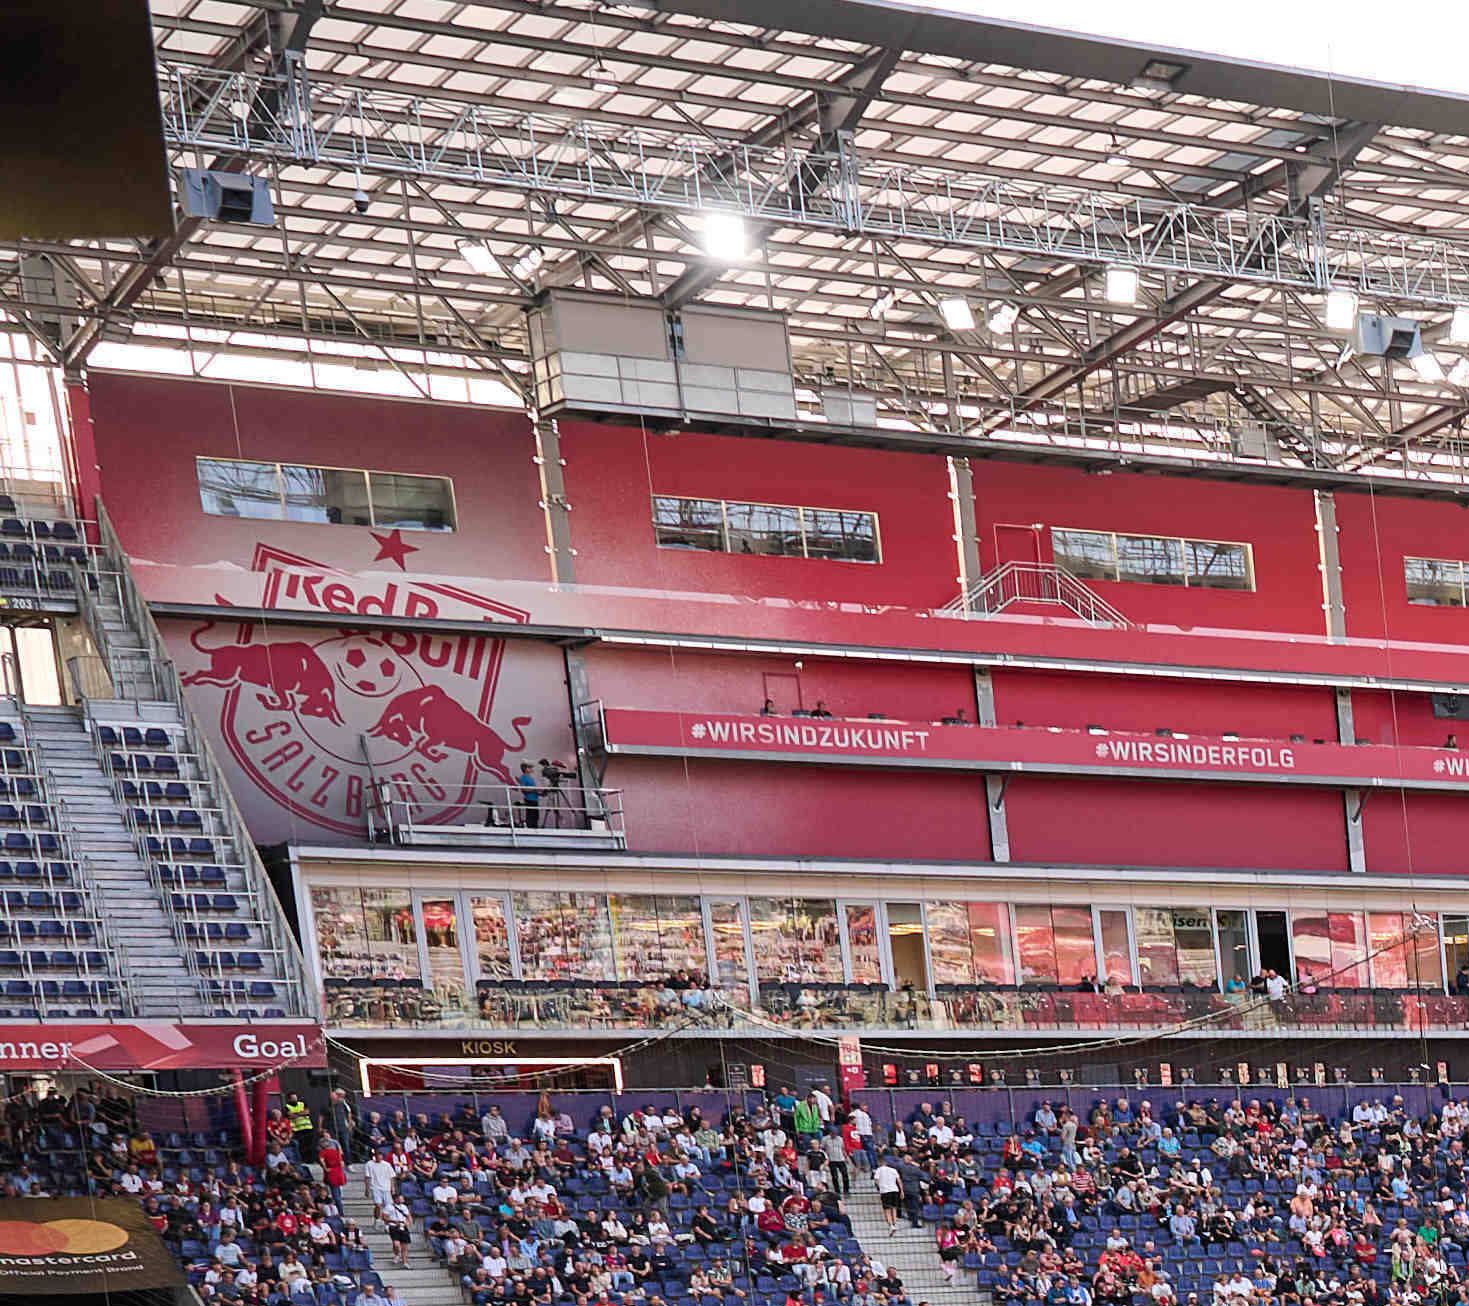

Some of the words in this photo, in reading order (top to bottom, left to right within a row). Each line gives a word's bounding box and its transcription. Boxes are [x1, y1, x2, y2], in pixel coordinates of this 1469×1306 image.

[691, 722, 930, 752] #WIRSINDZUKUNFT
[1095, 741, 1295, 768] #WIRSINDERFOLG
[233, 1034, 308, 1058] Goal
[462, 1041, 517, 1054] KIOSK
